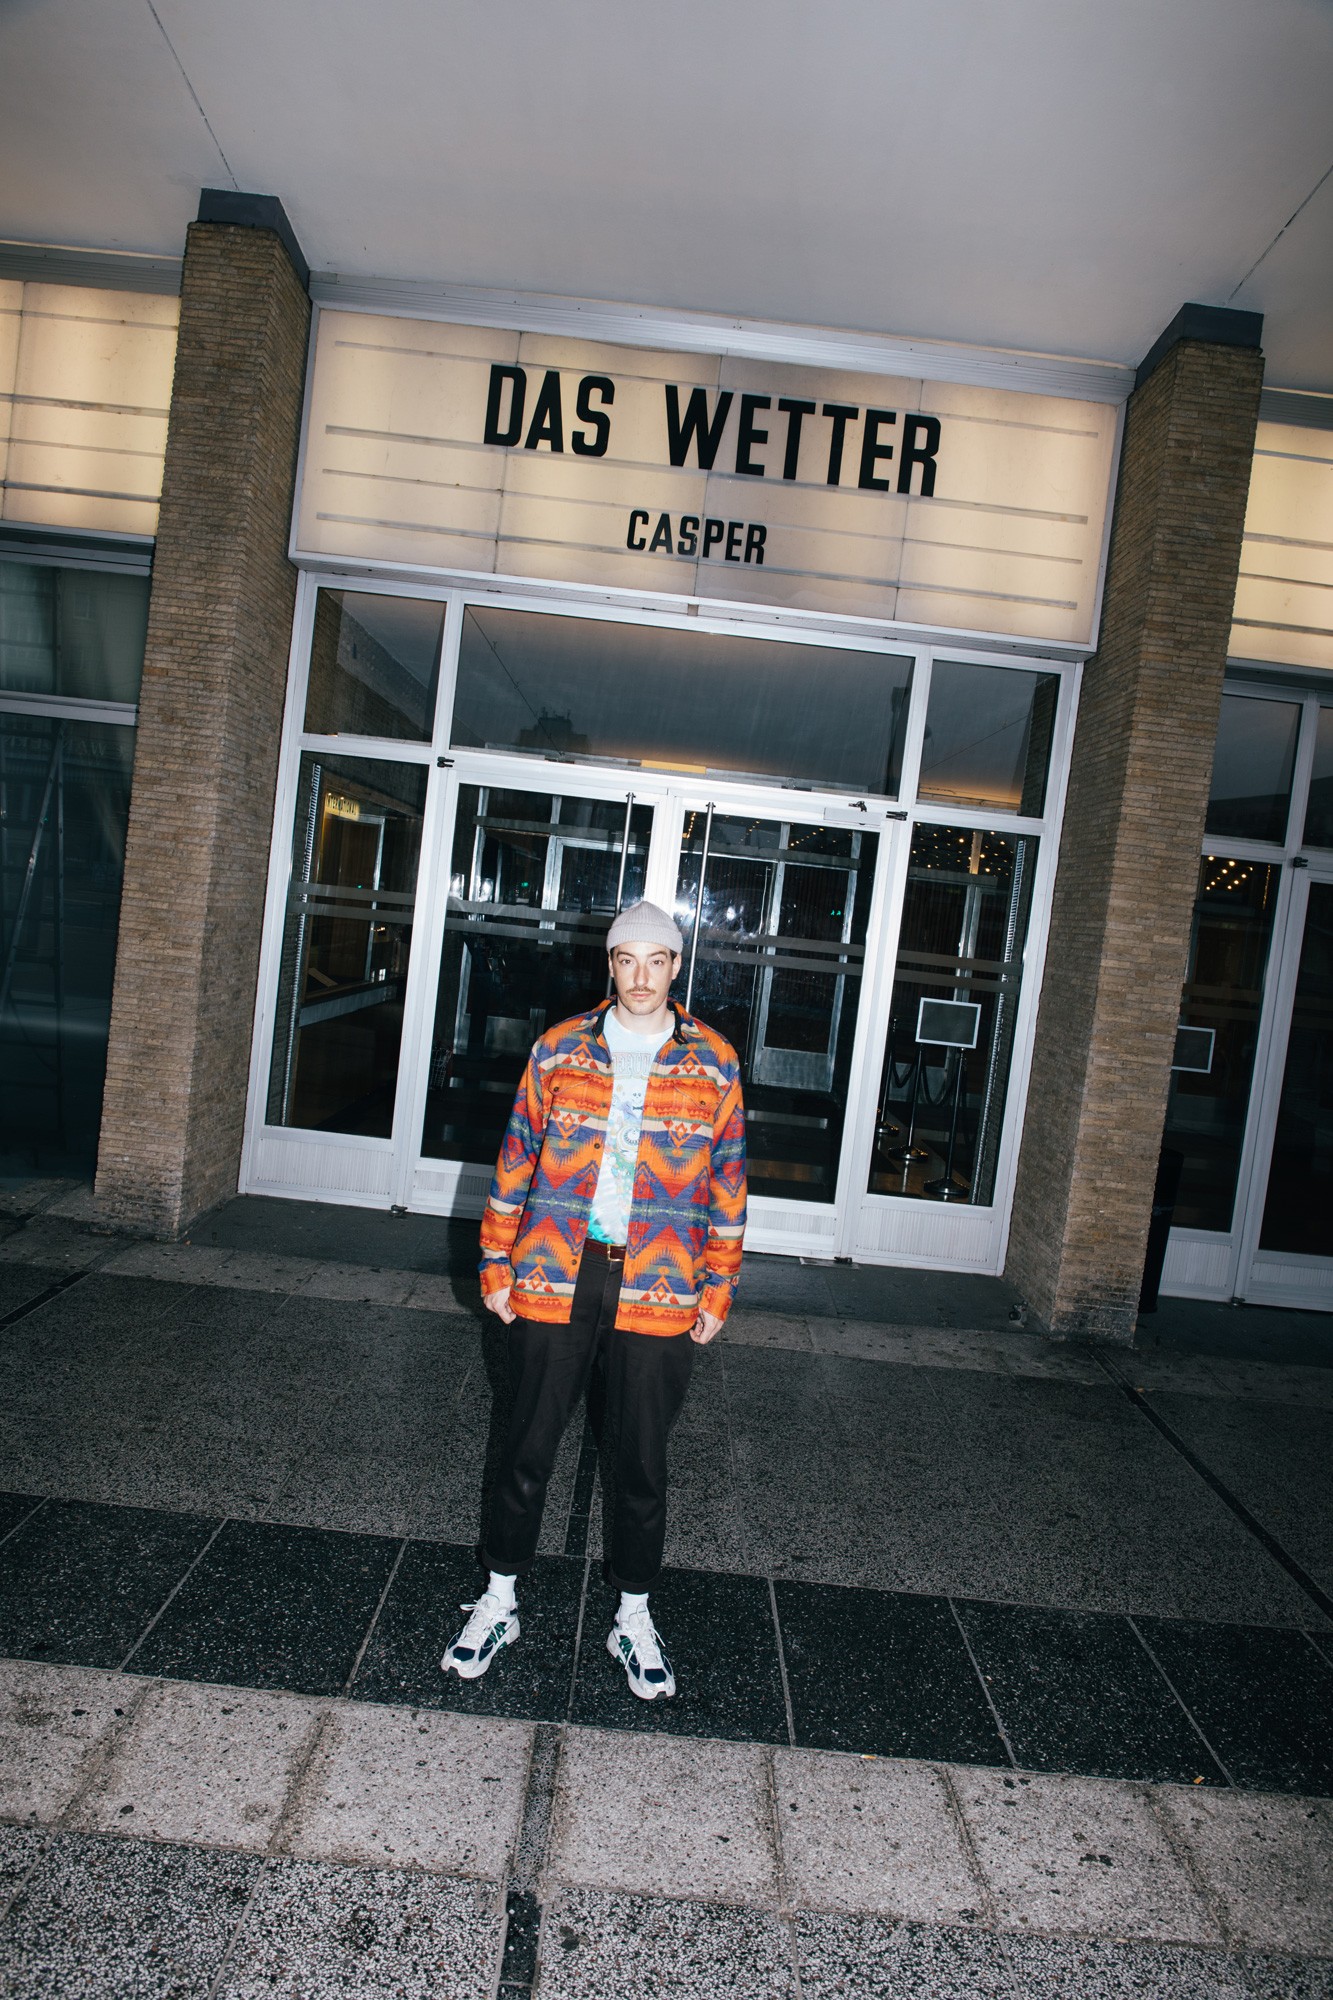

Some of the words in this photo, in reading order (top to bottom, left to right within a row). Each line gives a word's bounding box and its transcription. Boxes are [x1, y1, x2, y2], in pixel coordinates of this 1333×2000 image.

[483, 361, 616, 457] DAS
[664, 384, 942, 497] WETTER
[626, 509, 768, 565] CASPER
